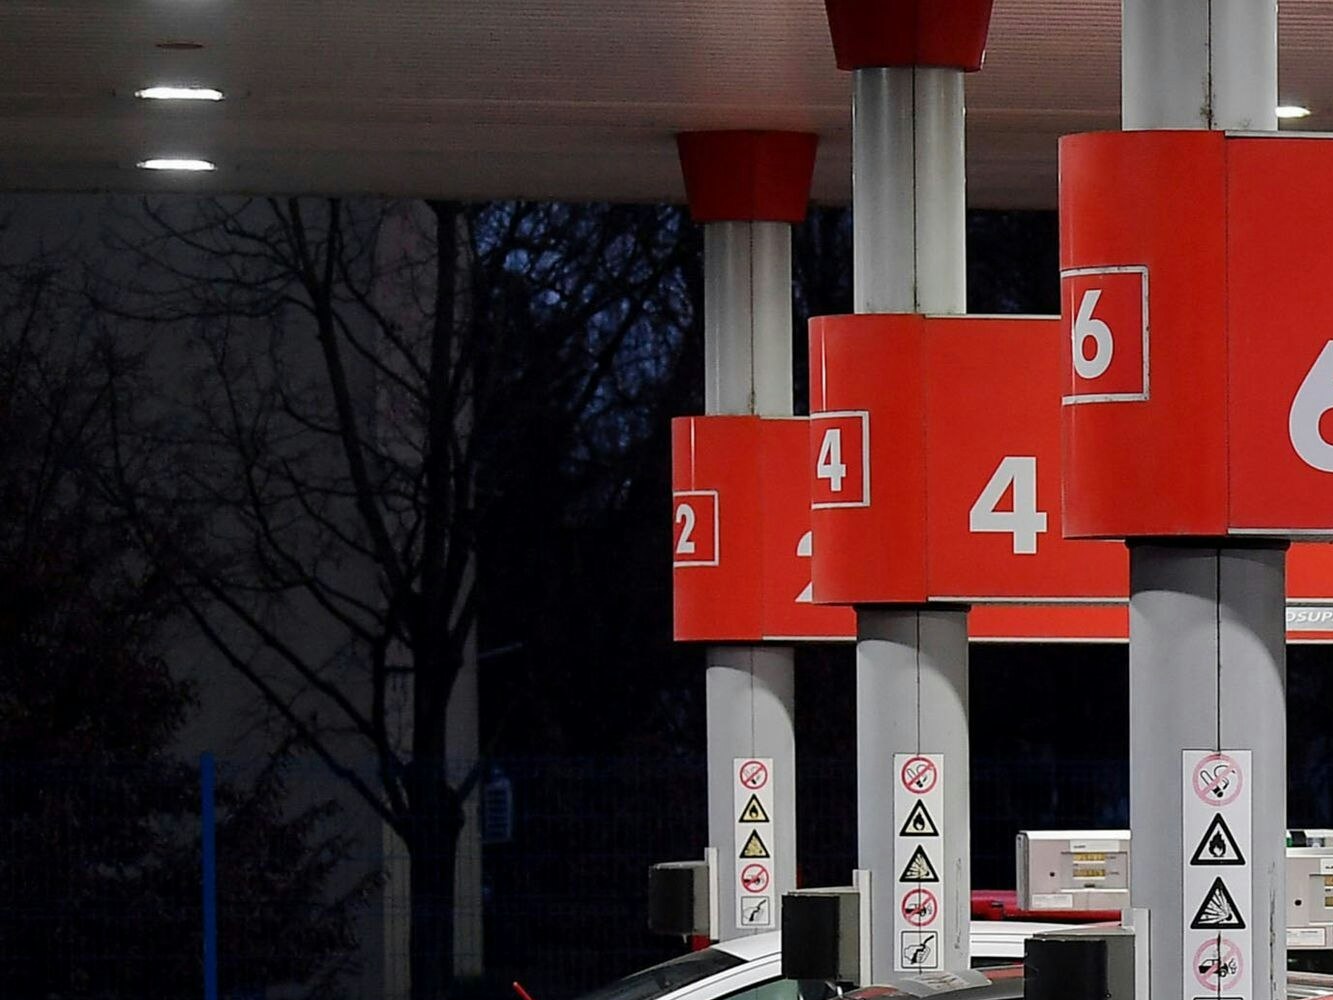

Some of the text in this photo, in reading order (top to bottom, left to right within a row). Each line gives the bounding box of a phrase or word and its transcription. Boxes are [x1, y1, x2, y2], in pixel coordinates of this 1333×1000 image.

[1072, 290, 1114, 379] 6
[816, 428, 846, 492] 4
[675, 503, 695, 554] 2
[969, 456, 1048, 554] 4
